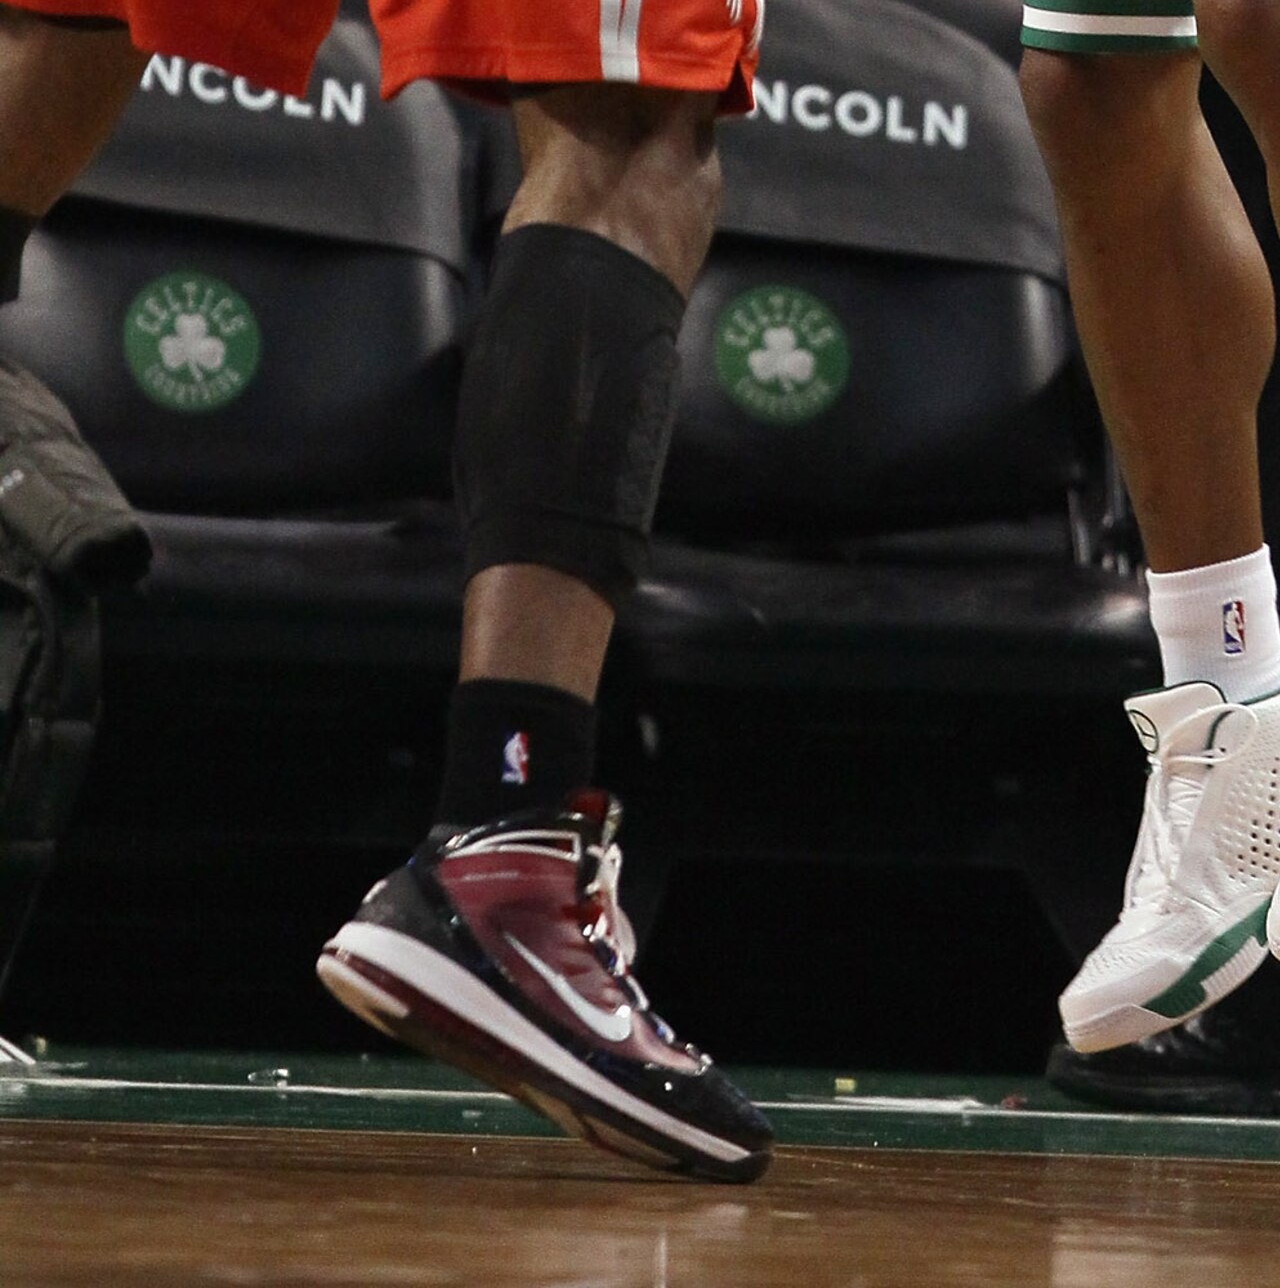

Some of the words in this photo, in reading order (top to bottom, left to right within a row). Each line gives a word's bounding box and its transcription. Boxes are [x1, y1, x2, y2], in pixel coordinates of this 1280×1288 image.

[140, 51, 366, 125] NCOLN
[746, 76, 968, 150] NCOLN
[136, 280, 245, 335] CELTICS
